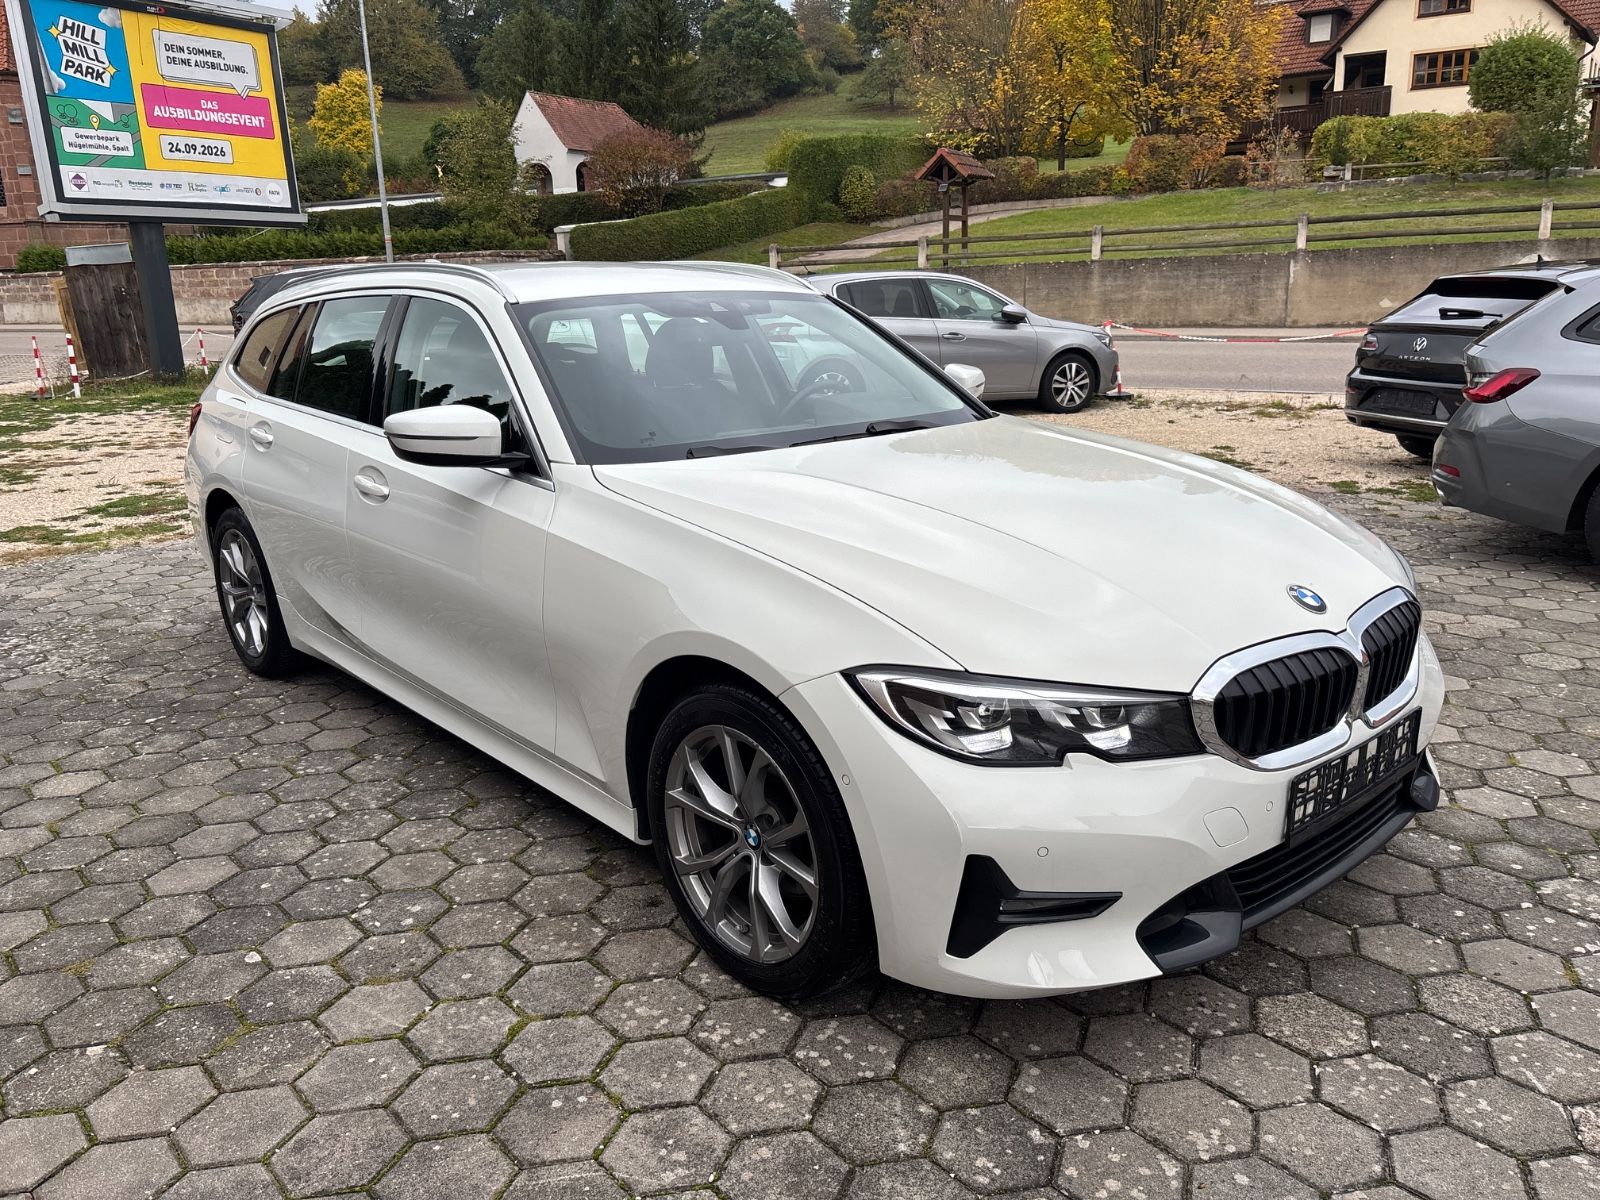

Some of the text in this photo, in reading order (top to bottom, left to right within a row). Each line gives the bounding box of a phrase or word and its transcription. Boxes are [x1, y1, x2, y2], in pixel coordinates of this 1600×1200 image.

[62, 18, 100, 45] HILL
[62, 39, 106, 65] MILL
[164, 43, 226, 61] DEIN SOMMER,
[64, 58, 107, 84] PARK
[166, 55, 249, 75] DEINE AUSBILDUNG.
[200, 99, 219, 110] DAS
[153, 105, 266, 128] AUSBILDUNGSEVENT
[68, 141, 130, 152] Hügelmühle, Spalt
[74, 132, 120, 142] Gewerbepark
[168, 142, 226, 157] 24.09.2026
